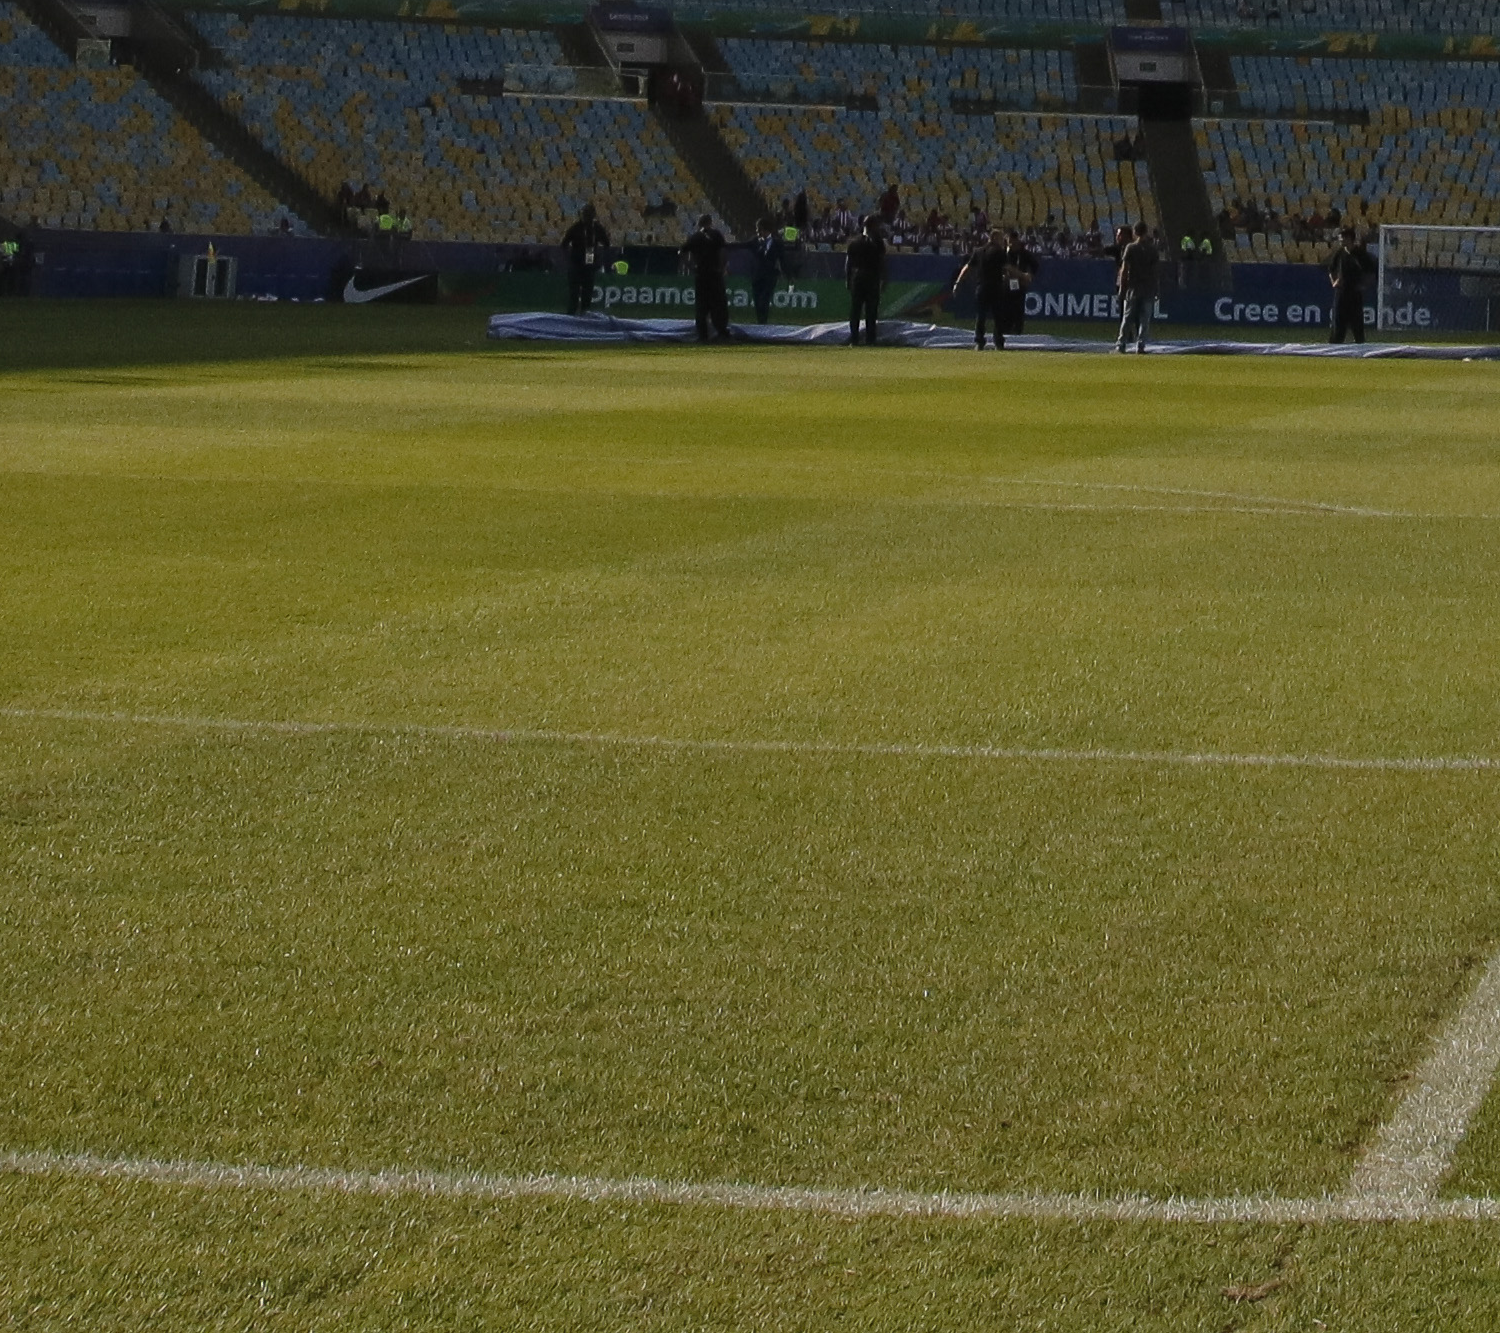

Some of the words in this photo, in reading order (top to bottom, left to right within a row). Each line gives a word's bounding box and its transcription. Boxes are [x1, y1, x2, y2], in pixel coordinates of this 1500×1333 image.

[1214, 296, 1279, 322] Cree
[1286, 304, 1321, 323] en
[1330, 301, 1431, 326] ande
